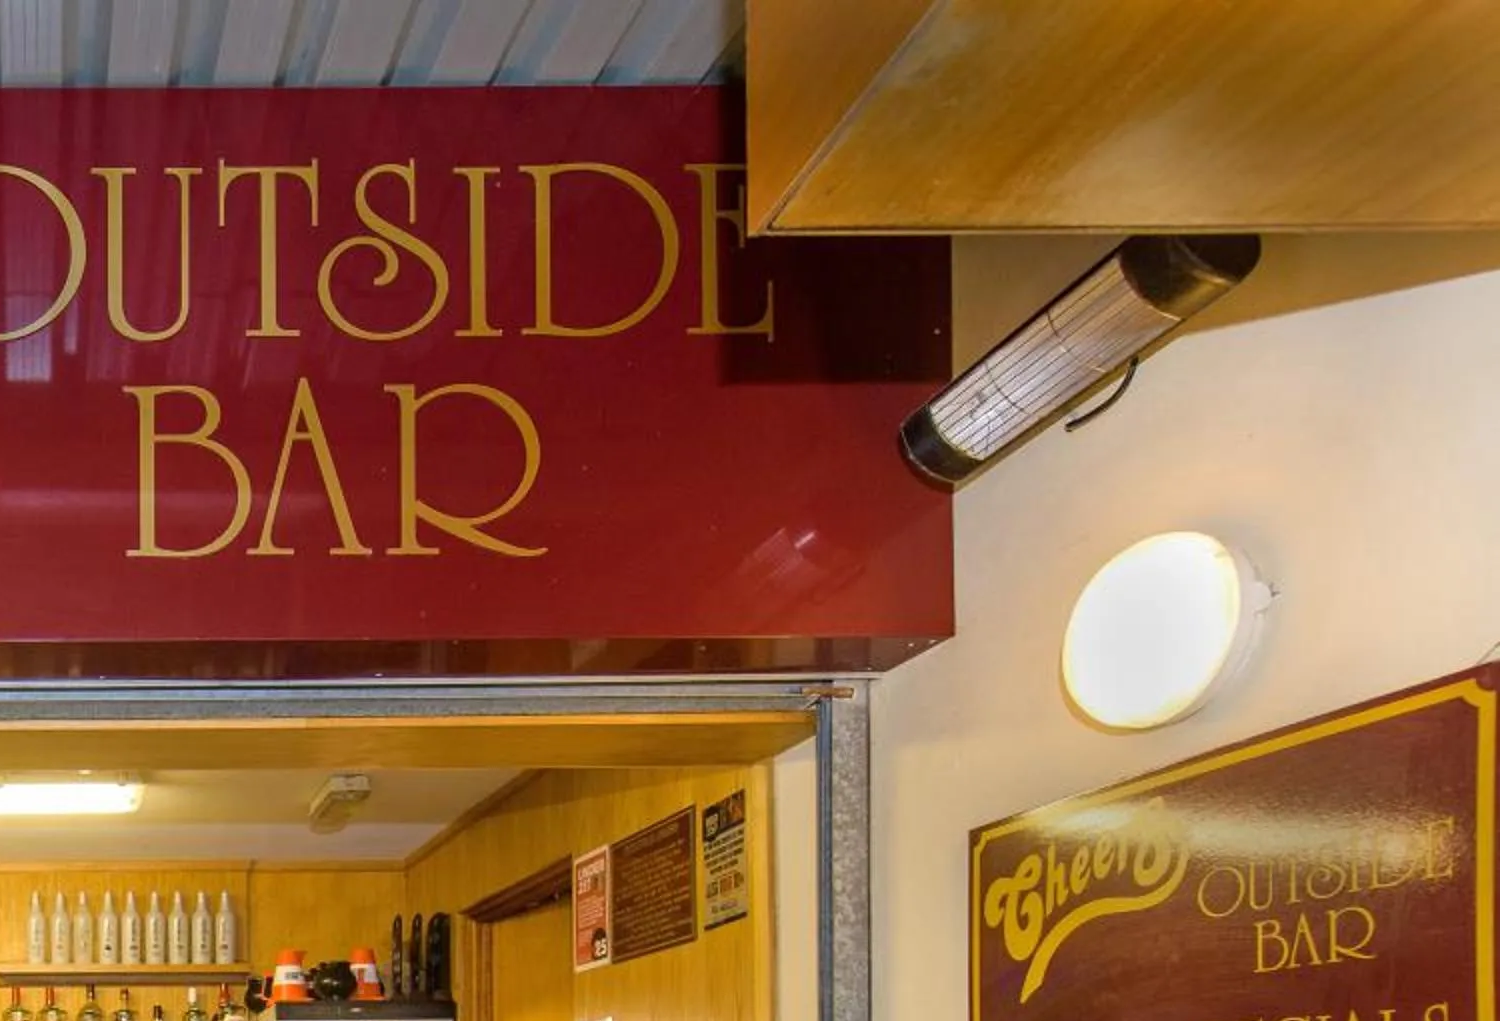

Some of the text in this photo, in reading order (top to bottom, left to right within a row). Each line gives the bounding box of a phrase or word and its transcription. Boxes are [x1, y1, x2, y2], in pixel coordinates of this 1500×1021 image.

[122, 377, 548, 557] BAR
[984, 797, 1191, 1004] Cheers
[1198, 816, 1455, 917] OUTSIDE
[1254, 906, 1377, 973] BAR
